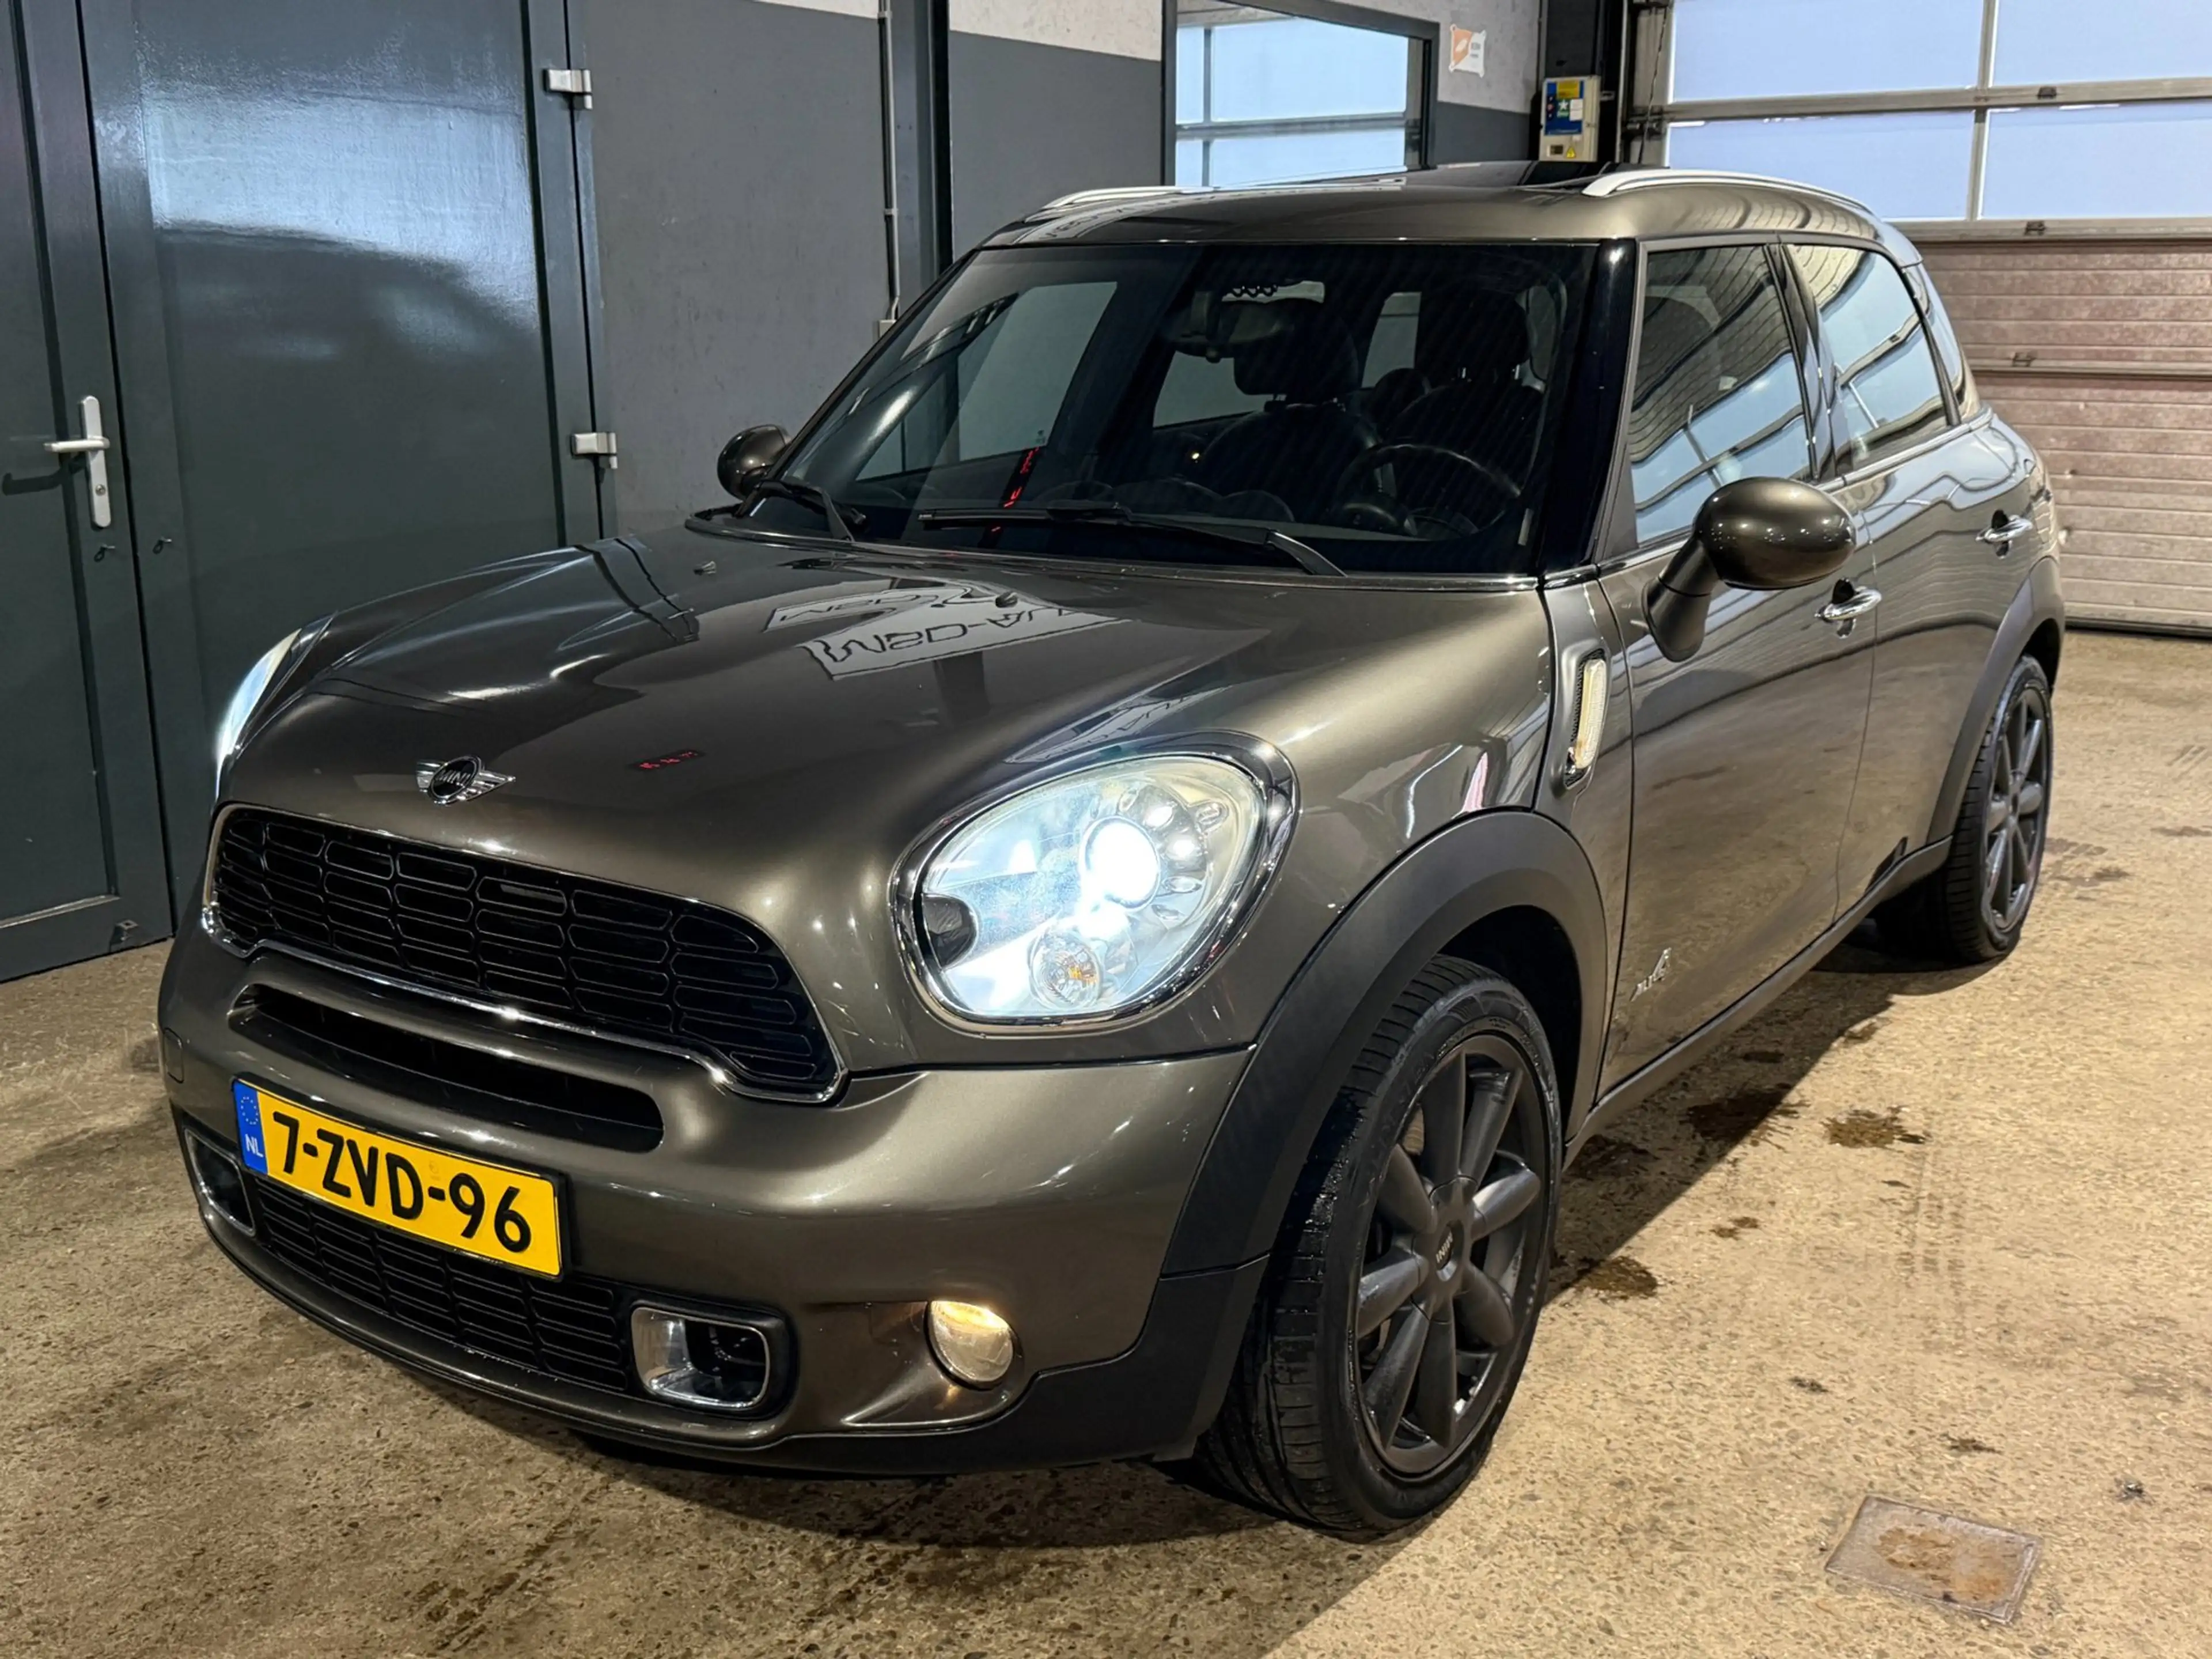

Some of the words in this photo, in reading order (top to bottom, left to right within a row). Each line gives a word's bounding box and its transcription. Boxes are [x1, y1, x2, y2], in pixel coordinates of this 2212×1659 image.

[245, 1133, 264, 1158] NL
[273, 1111, 531, 1252] 7-ZVD-96
[1435, 1229, 1453, 1264] MINI
